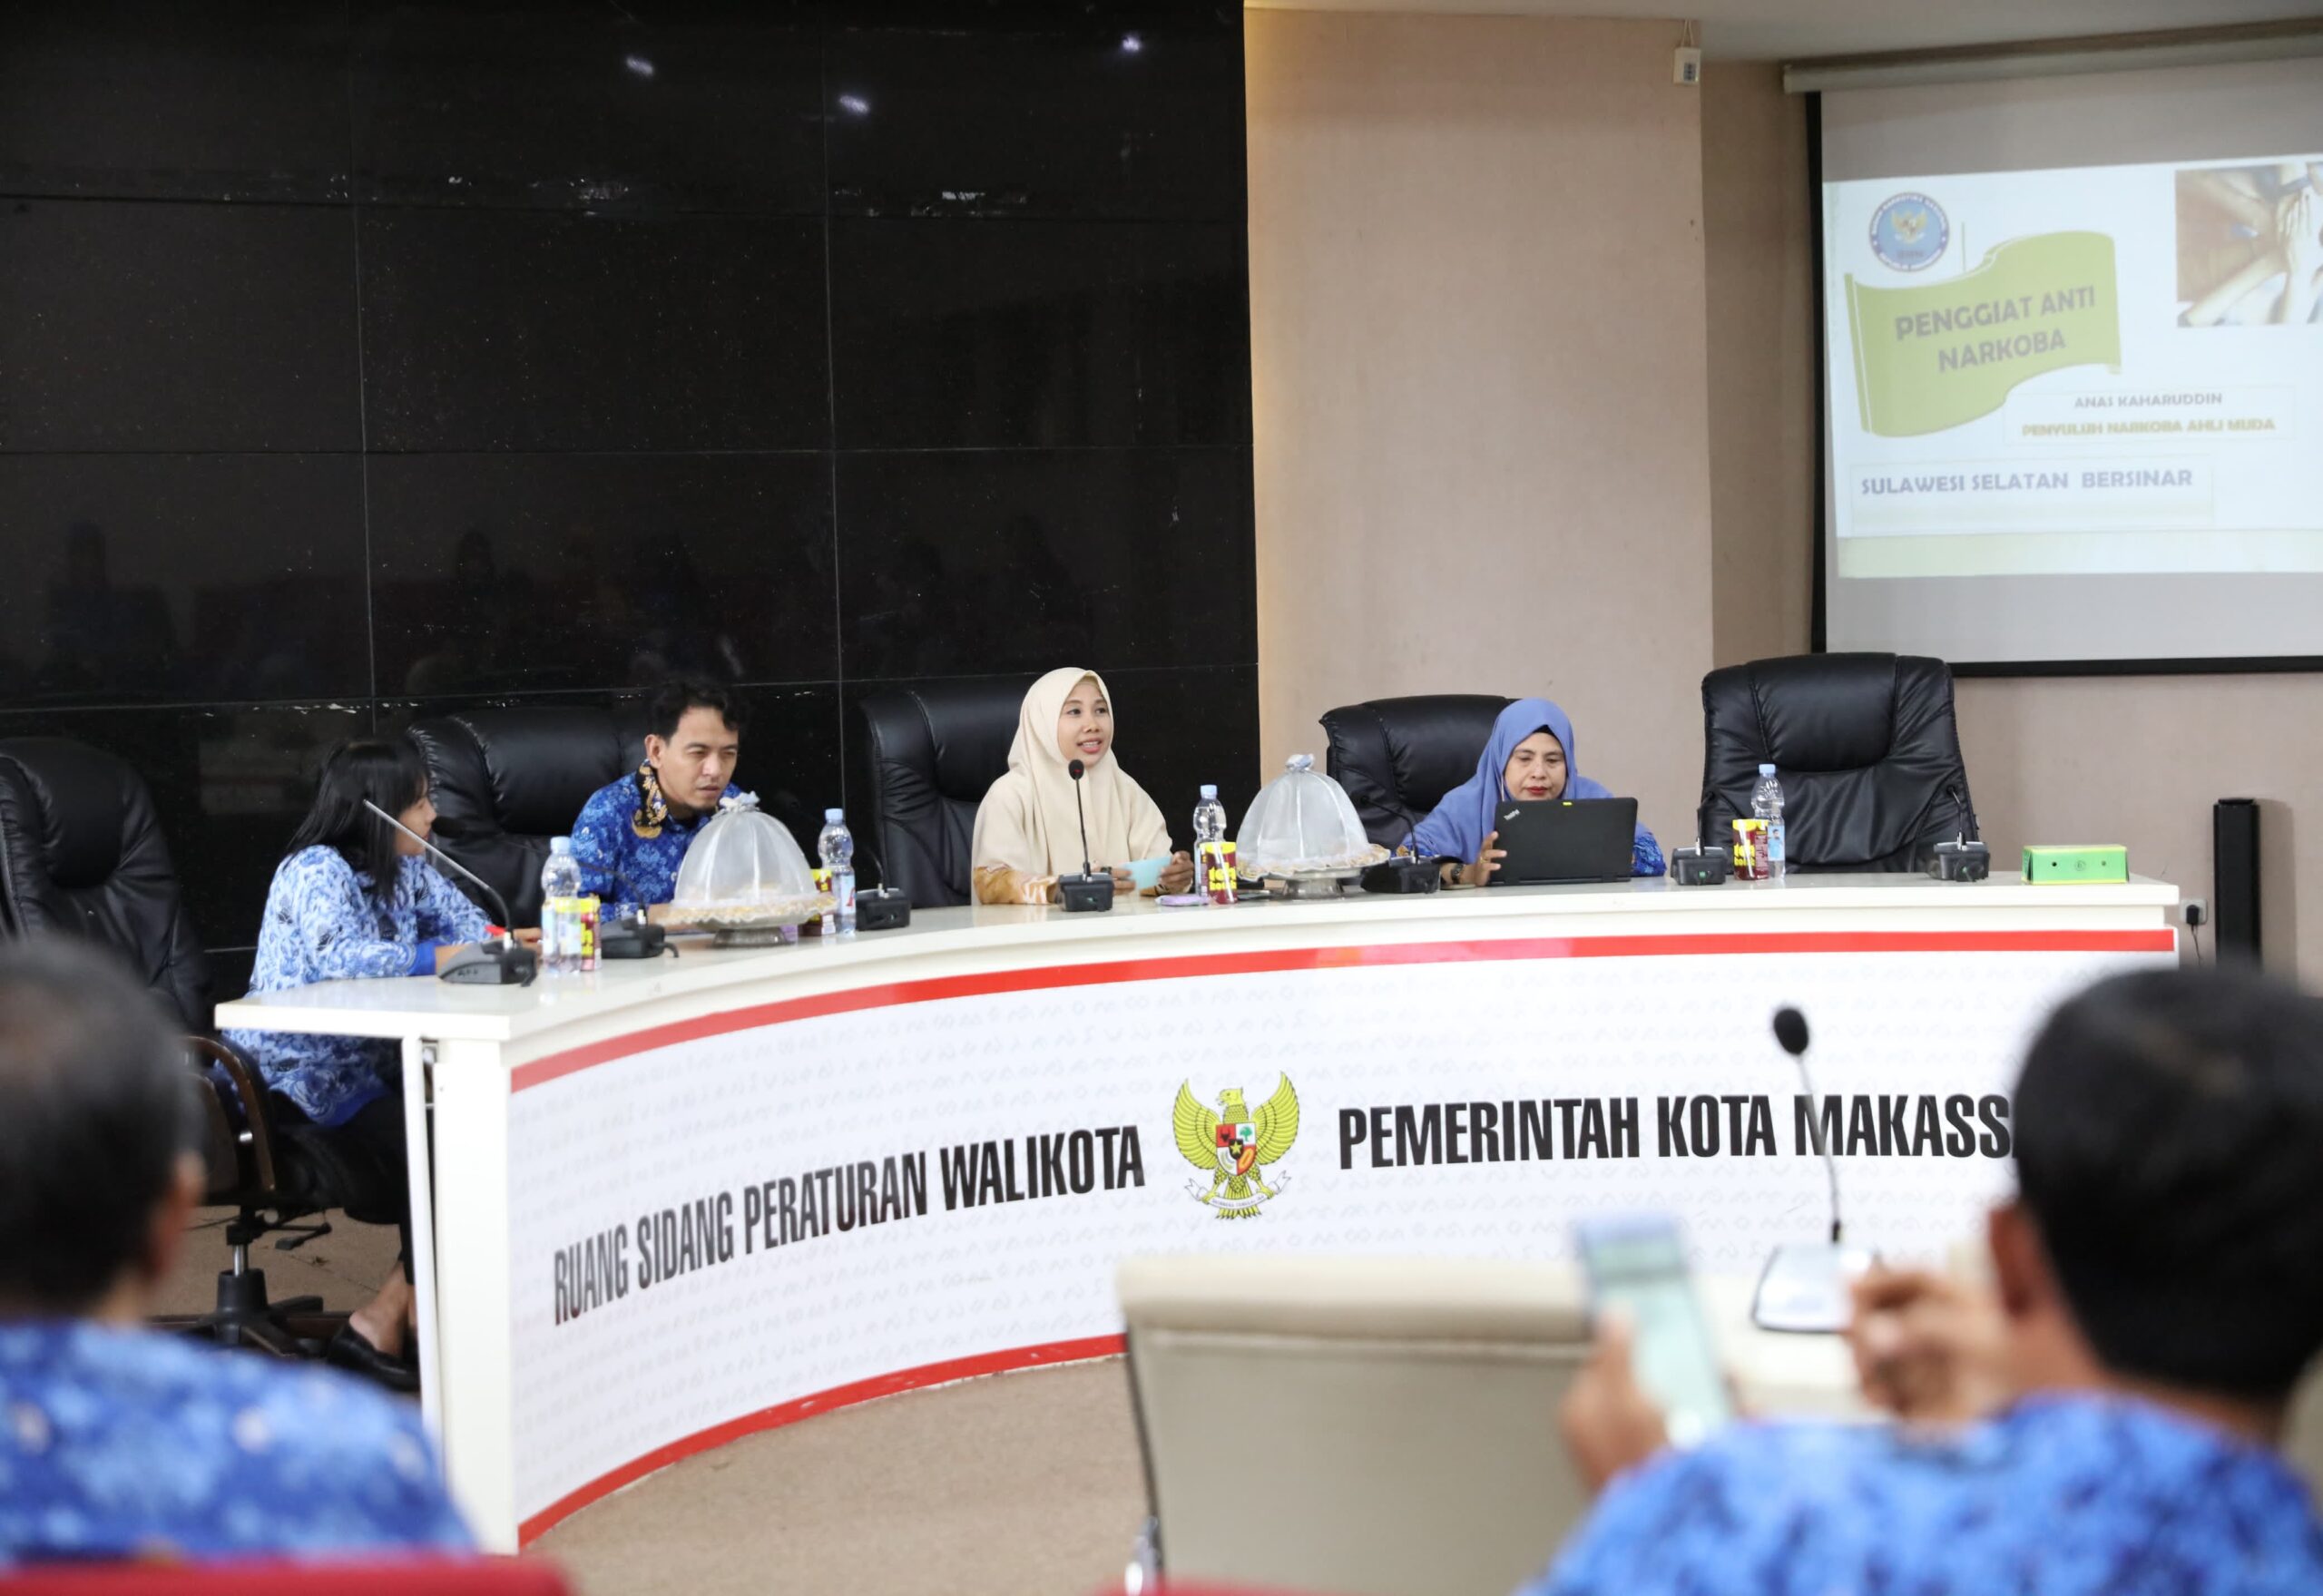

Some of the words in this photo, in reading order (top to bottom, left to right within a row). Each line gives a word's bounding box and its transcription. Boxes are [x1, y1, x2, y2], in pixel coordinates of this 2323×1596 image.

[1895, 296, 2033, 341] PENGGIAT
[2040, 286, 2095, 317] ANTI
[1938, 328, 2067, 372] NARKOBA
[2074, 396, 2113, 408] ANAS
[2118, 392, 2222, 407] KAHARUDDIN
[2022, 422, 2103, 436] PENYULUH
[2107, 420, 2182, 434] NARKOBA
[2228, 417, 2276, 431] MUDA
[1861, 475, 1965, 495] SULAWESI
[1972, 471, 2069, 492] SELATAN
[2082, 469, 2193, 490] BERSINAR
[1338, 1095, 1640, 1170] PEMERINTAH
[1656, 1093, 1778, 1158] KOTA
[1793, 1093, 2018, 1159] MAKASS
[554, 1223, 630, 1327] RUANG
[636, 1190, 734, 1290] SIDANG
[744, 1150, 928, 1256] PERATURAN
[938, 1124, 1146, 1211] WALIKOTA
